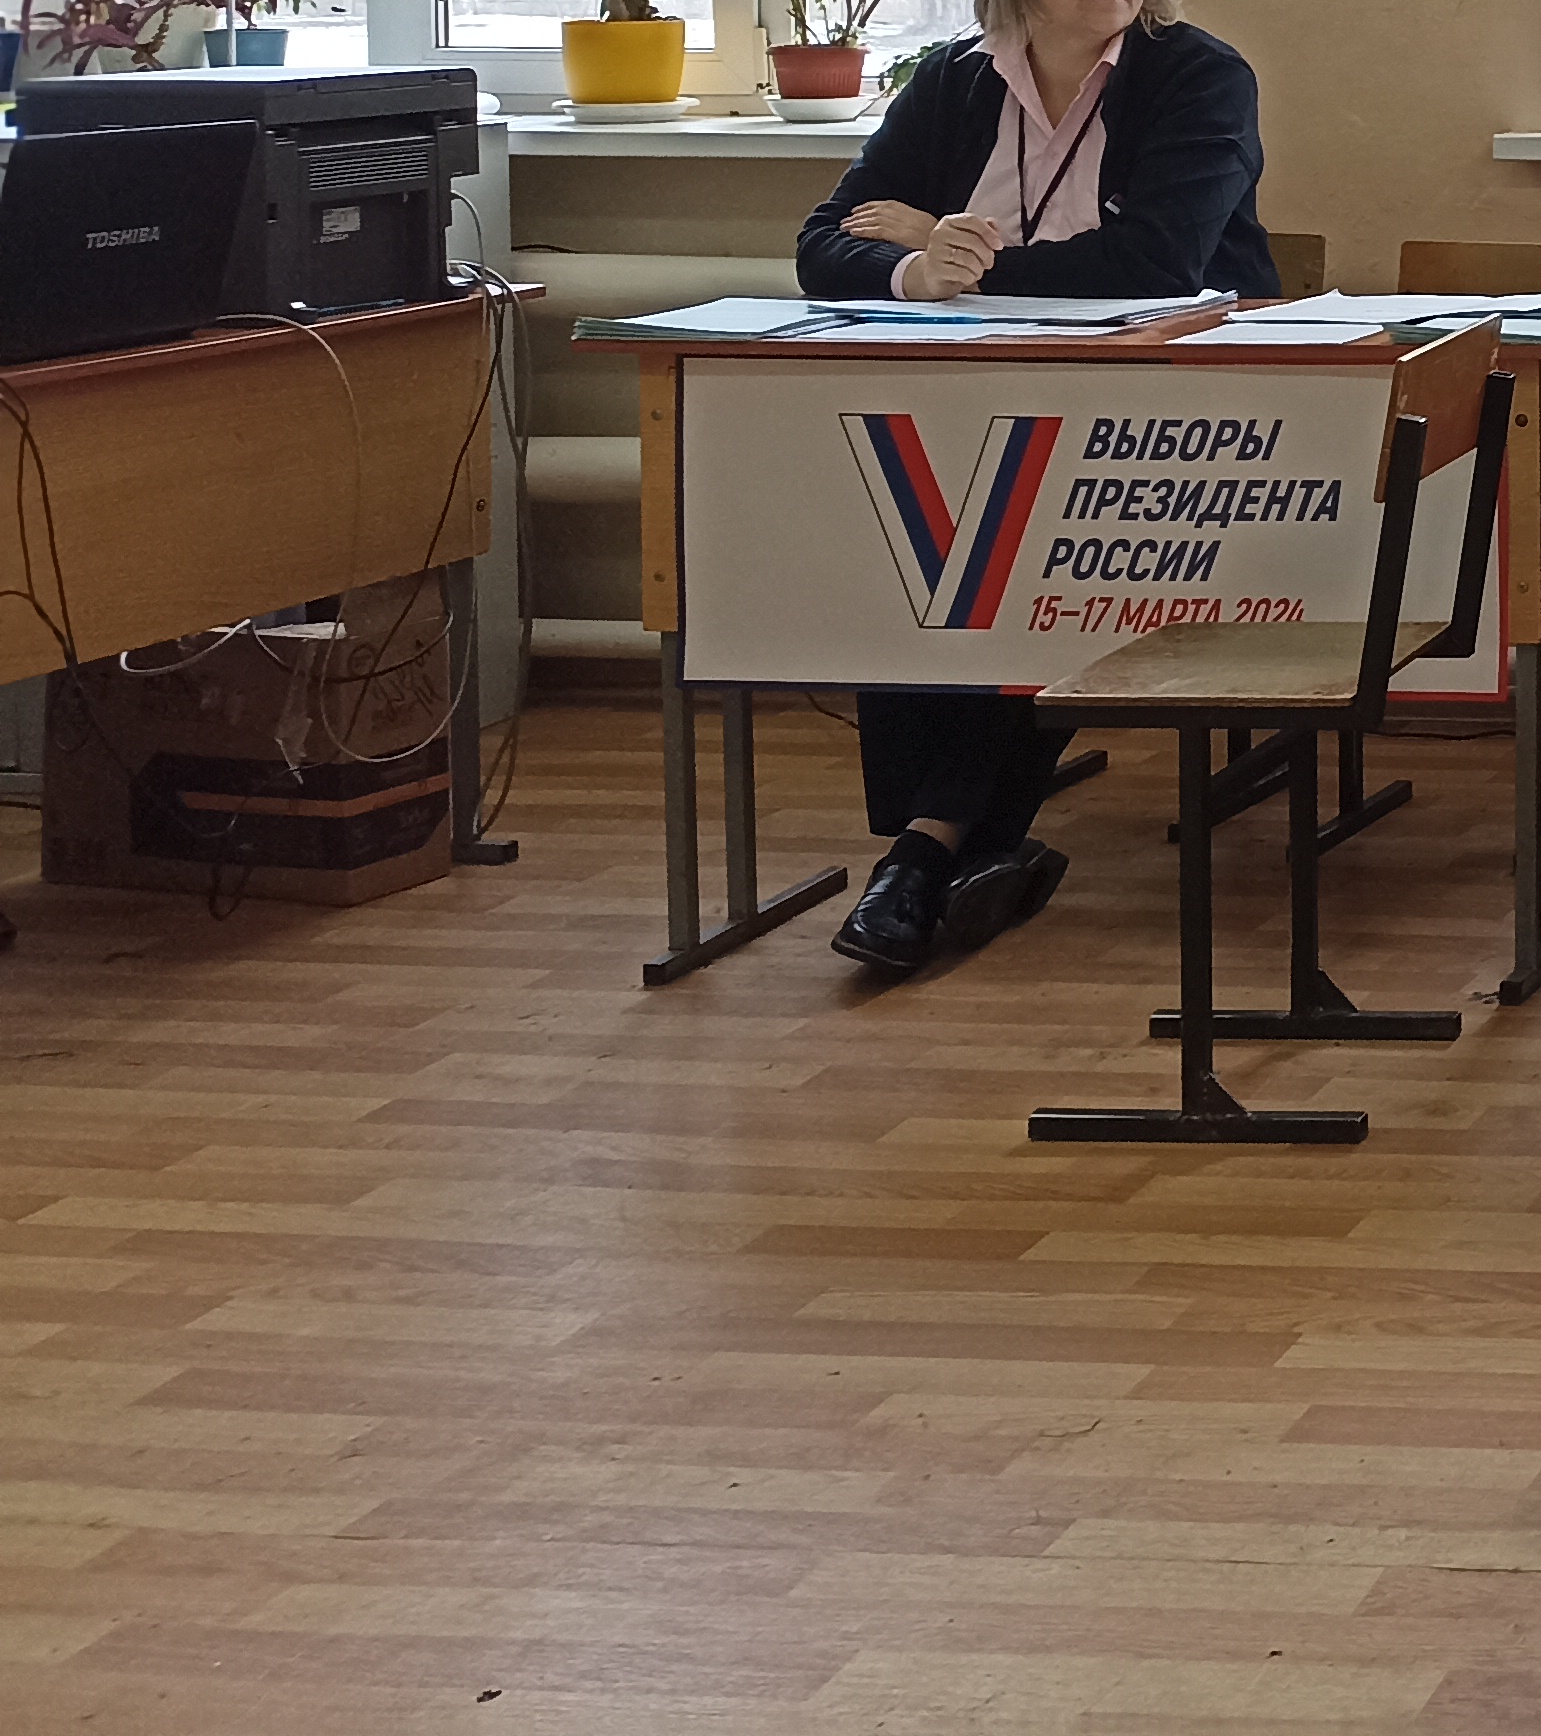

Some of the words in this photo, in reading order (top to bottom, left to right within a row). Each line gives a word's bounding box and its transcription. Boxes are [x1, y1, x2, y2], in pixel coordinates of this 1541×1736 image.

[86, 226, 160, 249] TOSHIBA
[1083, 418, 1283, 461] ВЫБОРЫ
[1062, 479, 1343, 527] ПРЕЗИДЕНТА
[1041, 538, 1221, 582] РОССИИ
